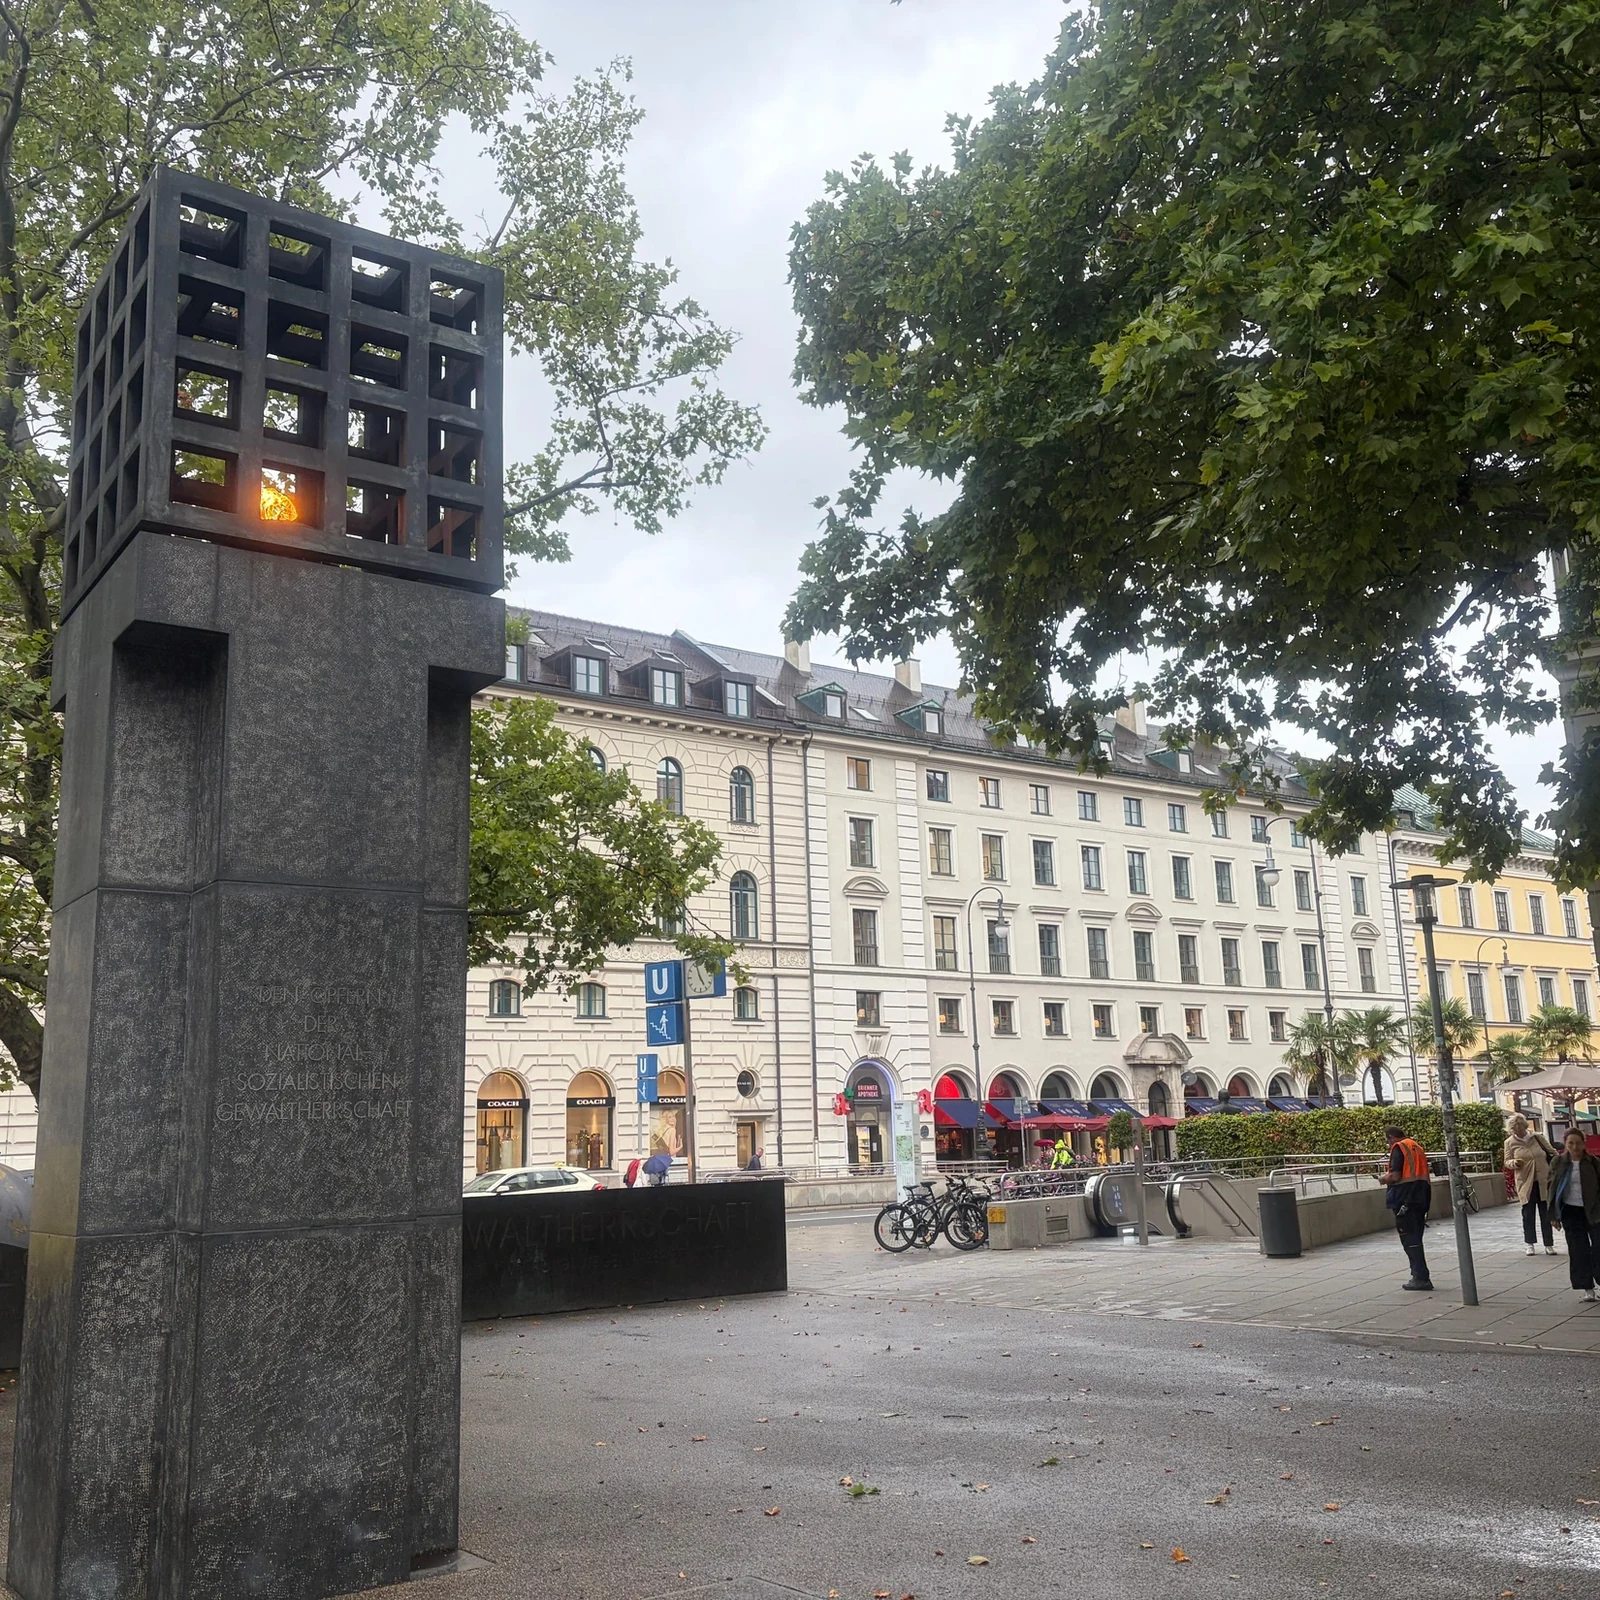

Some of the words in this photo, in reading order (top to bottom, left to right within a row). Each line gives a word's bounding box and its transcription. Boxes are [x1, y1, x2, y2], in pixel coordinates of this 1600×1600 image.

[652, 968, 668, 995] U
[259, 985, 299, 1003] DEN
[310, 986, 381, 1004] OPFERN
[304, 1015, 337, 1033] DER
[640, 1058, 647, 1074] U
[237, 1072, 397, 1091] SOZIALISTISCHEN
[216, 1100, 413, 1122] GEWALTHERRSCHAFT
